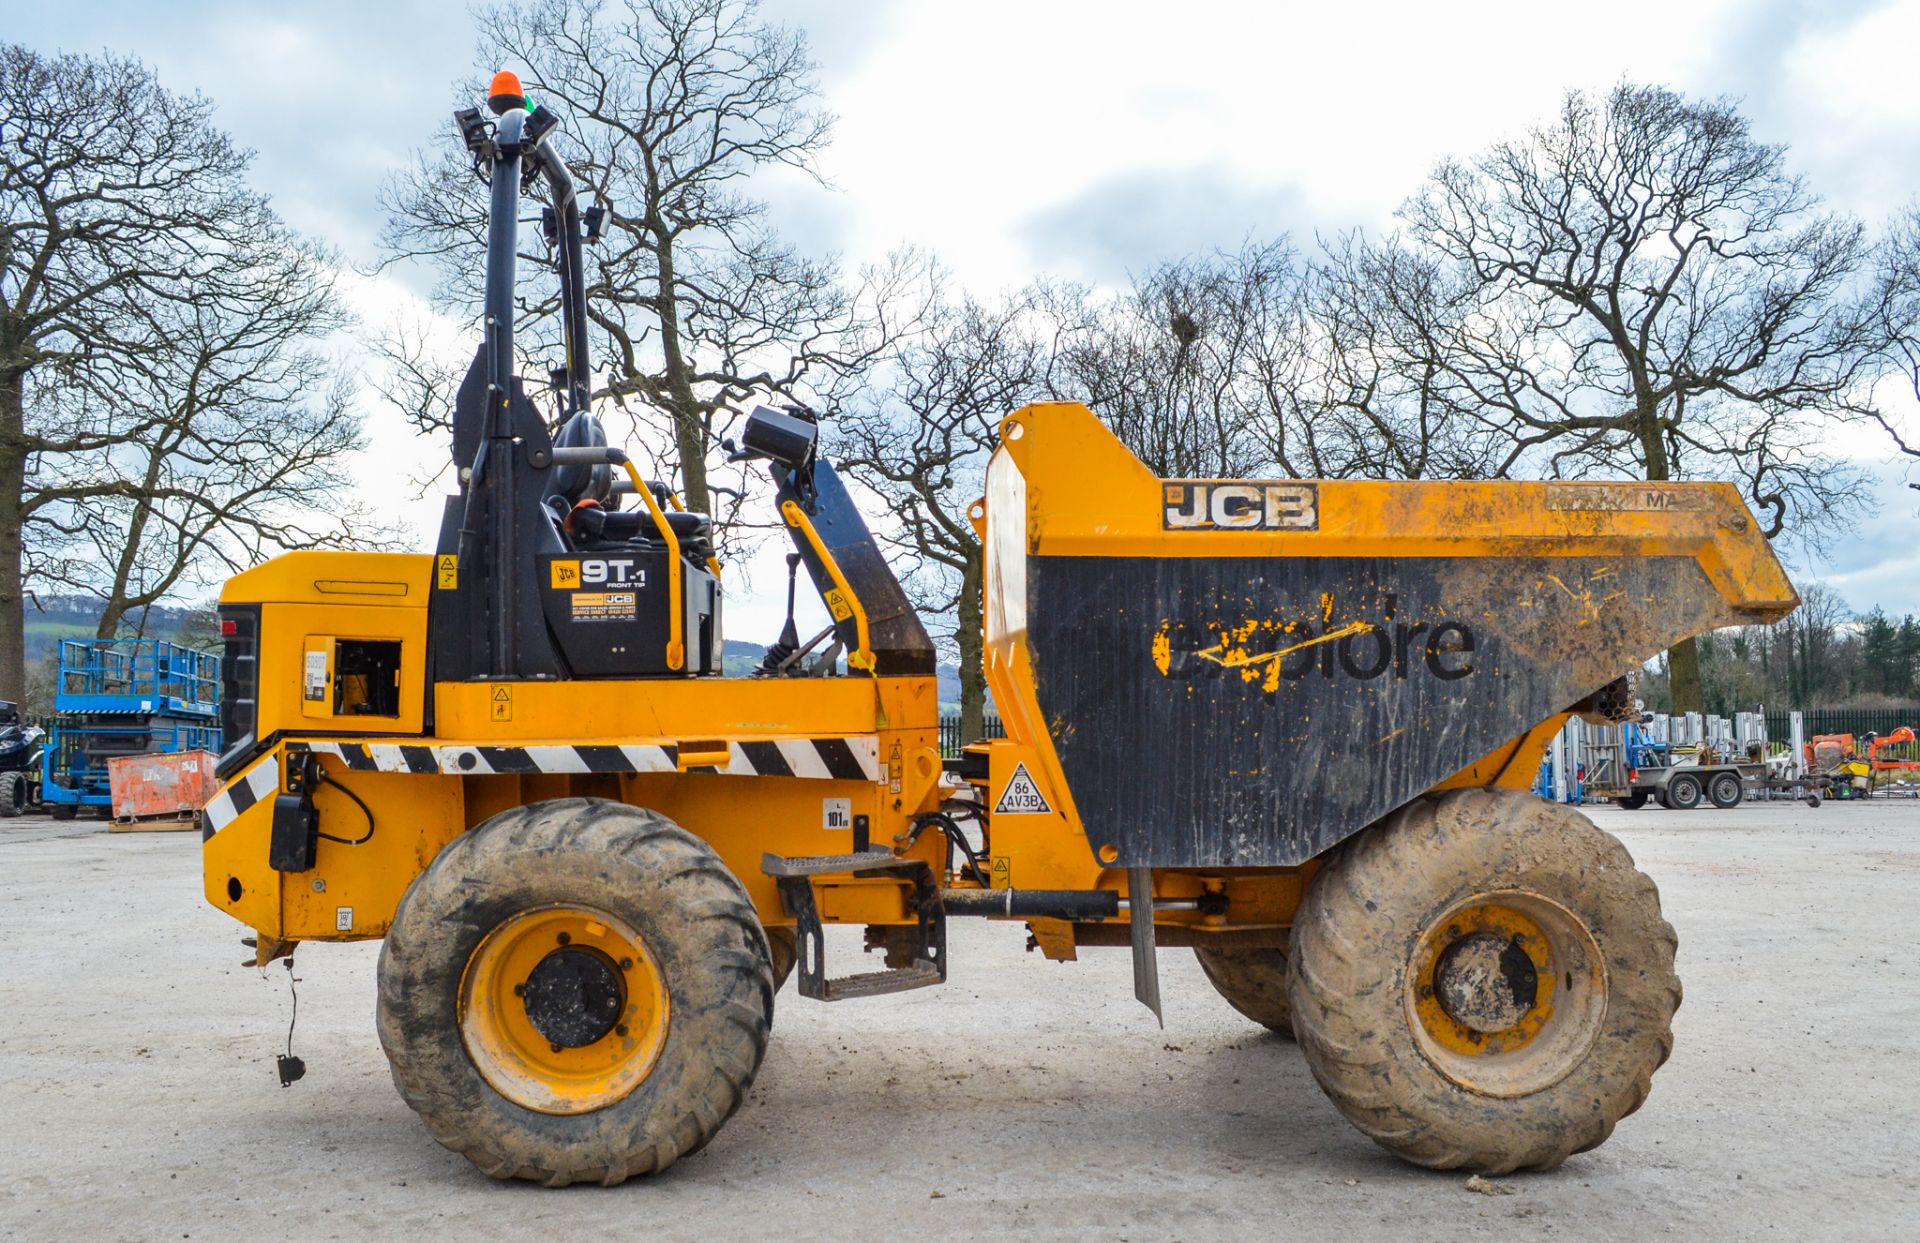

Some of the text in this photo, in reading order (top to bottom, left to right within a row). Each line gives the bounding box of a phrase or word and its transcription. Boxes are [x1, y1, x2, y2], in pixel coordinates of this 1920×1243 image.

[1166, 485, 1316, 527] JCB
[560, 568, 576, 580] JCB
[607, 595, 633, 603] JCB
[1014, 782, 1029, 795] 86
[1007, 795, 1039, 808] AV3B
